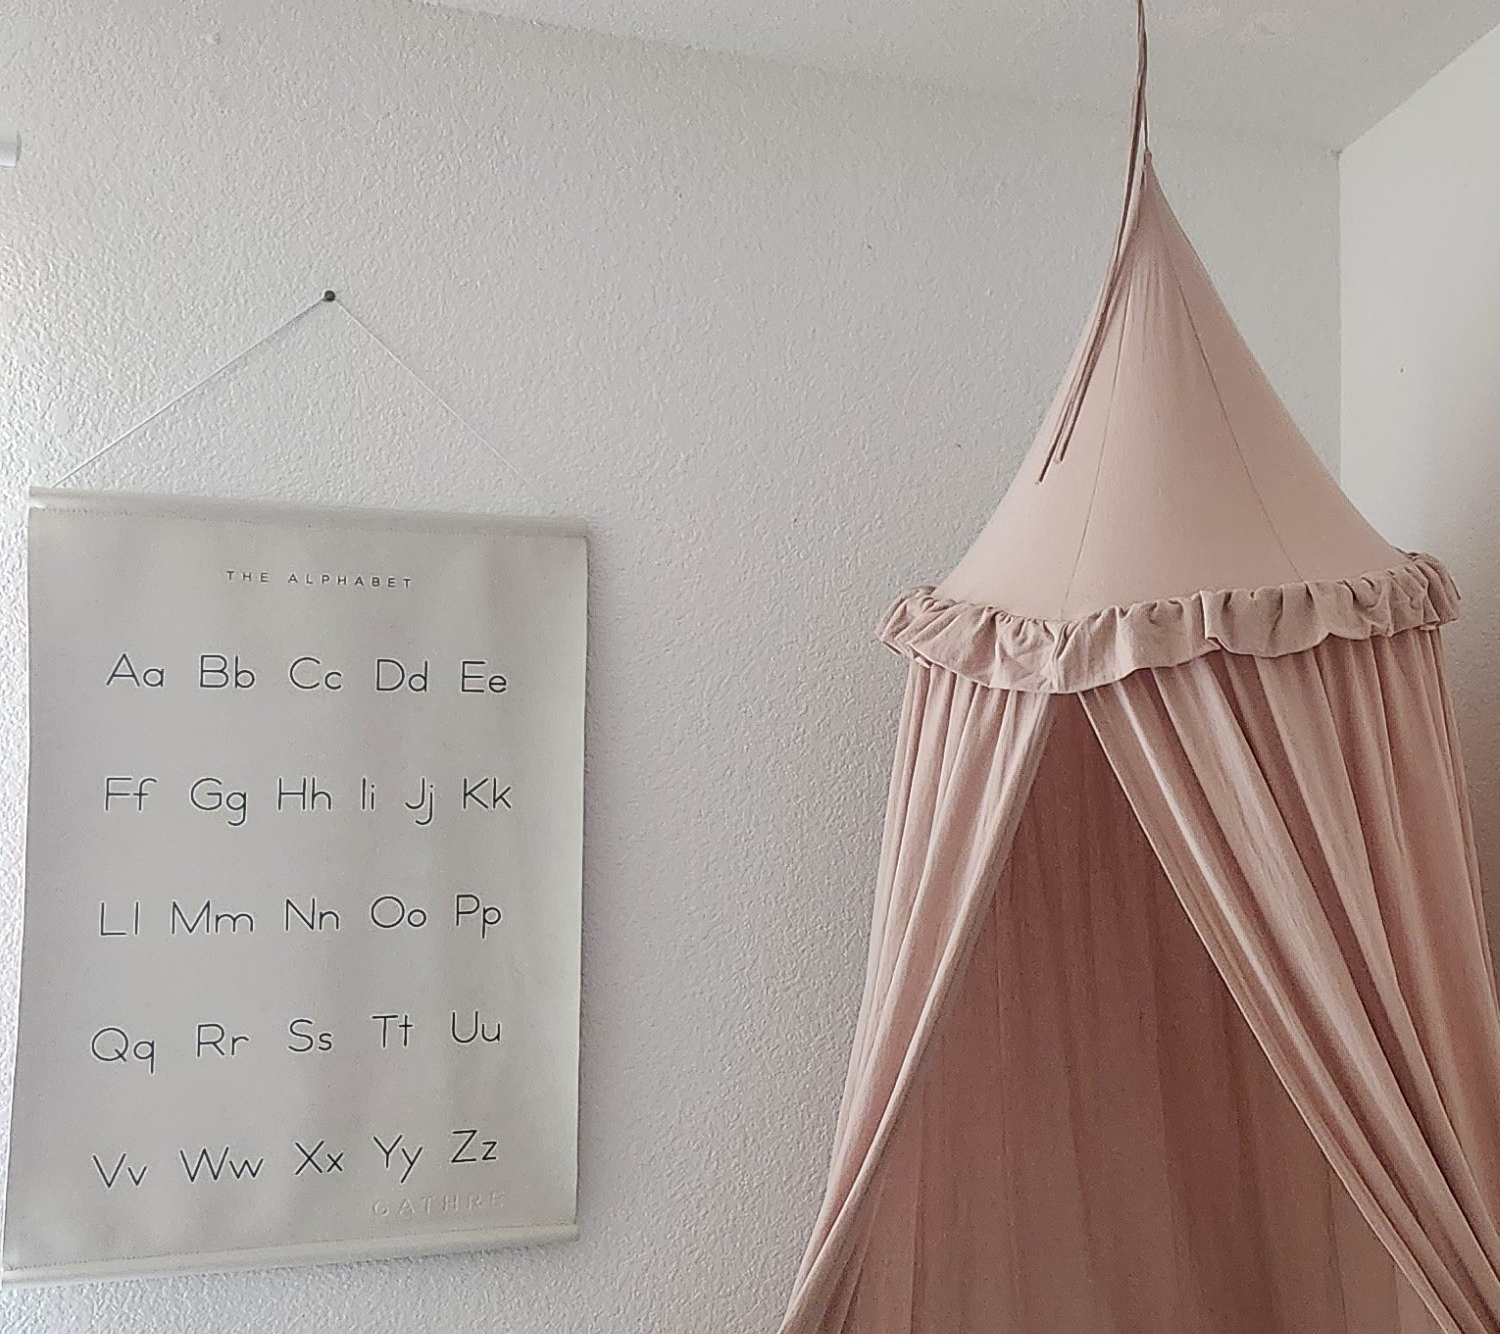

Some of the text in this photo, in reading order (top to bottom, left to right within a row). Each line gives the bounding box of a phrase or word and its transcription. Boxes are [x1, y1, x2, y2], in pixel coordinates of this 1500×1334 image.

[225, 570, 412, 589] THE ALPHABET
[104, 652, 507, 694] Aa Bb Cc Dd Ee
[104, 776, 512, 827] Ff Gg Hh Ii Jj Kk
[99, 893, 502, 940] Ll Mm Nn Oo Pp
[91, 1010, 501, 1074] Qq Rr Ss Tt Uu
[92, 1129, 498, 1189] Vv Ww Xx Yy Zz
[371, 1189, 506, 1217] GATHRE
